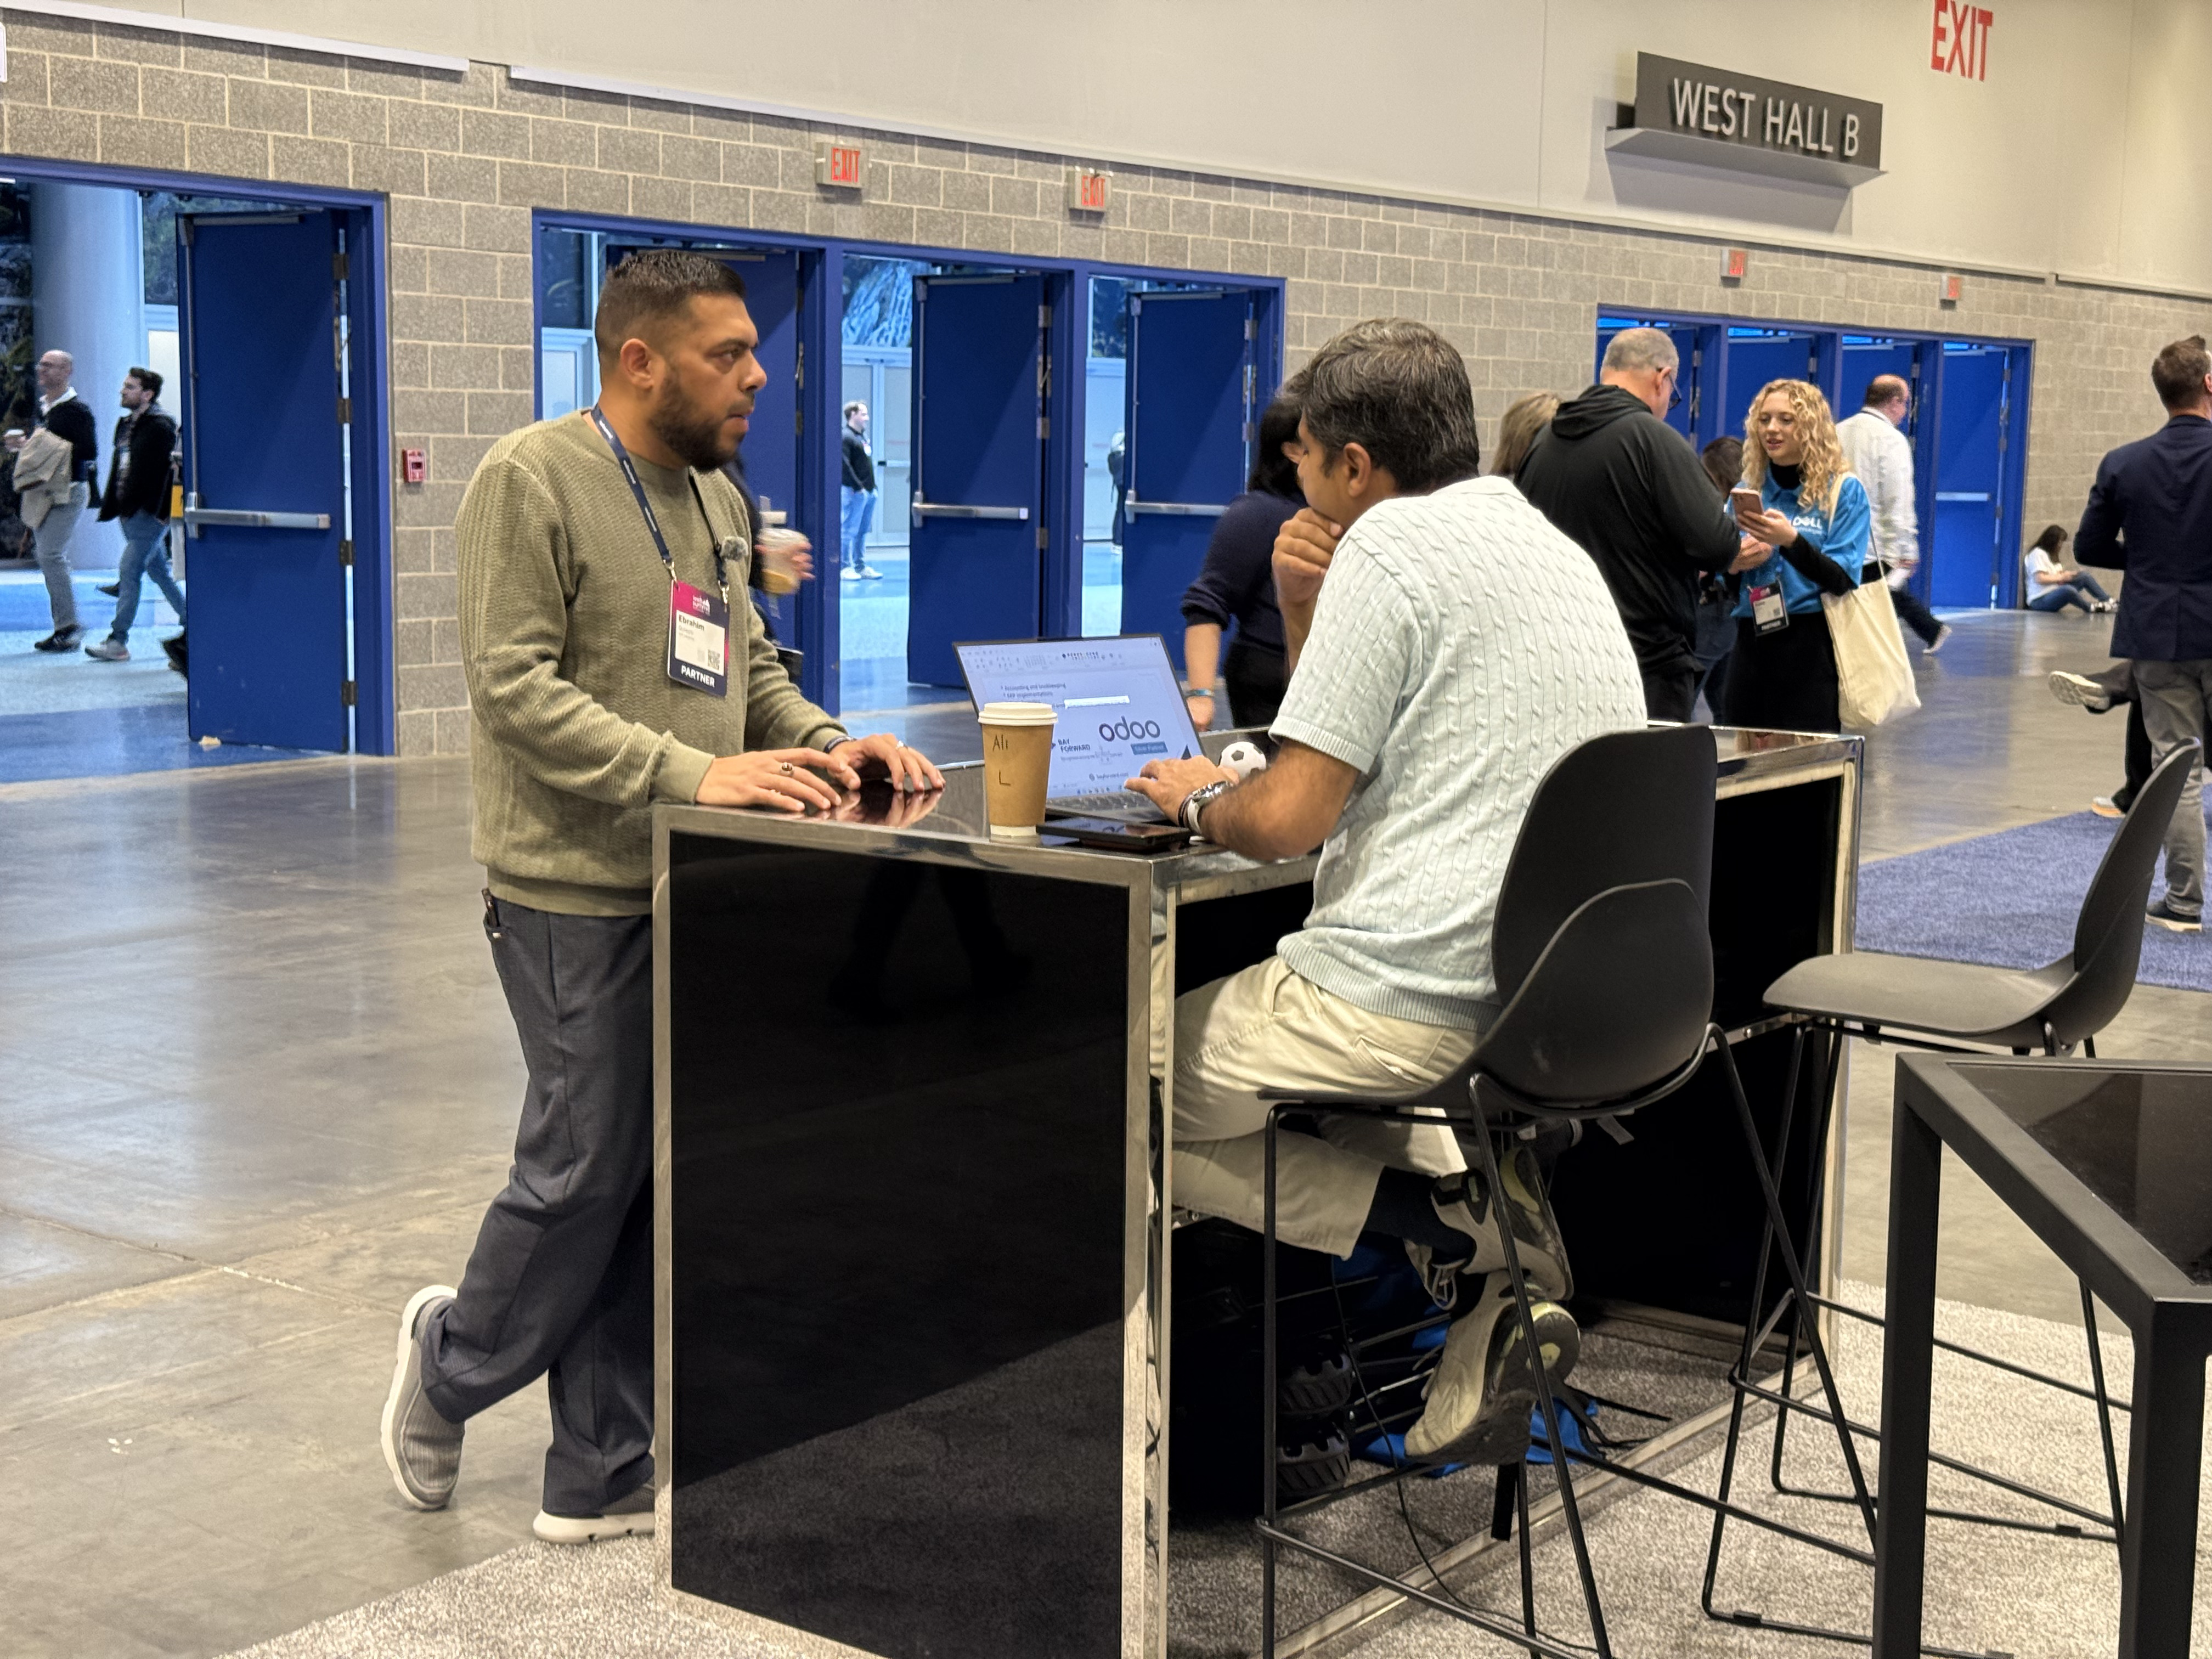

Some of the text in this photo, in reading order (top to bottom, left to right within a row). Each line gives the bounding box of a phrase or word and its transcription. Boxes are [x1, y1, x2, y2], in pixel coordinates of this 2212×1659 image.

[1931, 0, 1993, 82] EXIT
[1673, 77, 1859, 157] WEST HALL B
[832, 147, 860, 184] EXIT
[1081, 175, 1105, 208] EXIT
[679, 614, 704, 631] Ebrahim
[681, 665, 715, 687] PARTNER
[1099, 715, 1161, 742] odoo
[998, 769, 1011, 786] L
